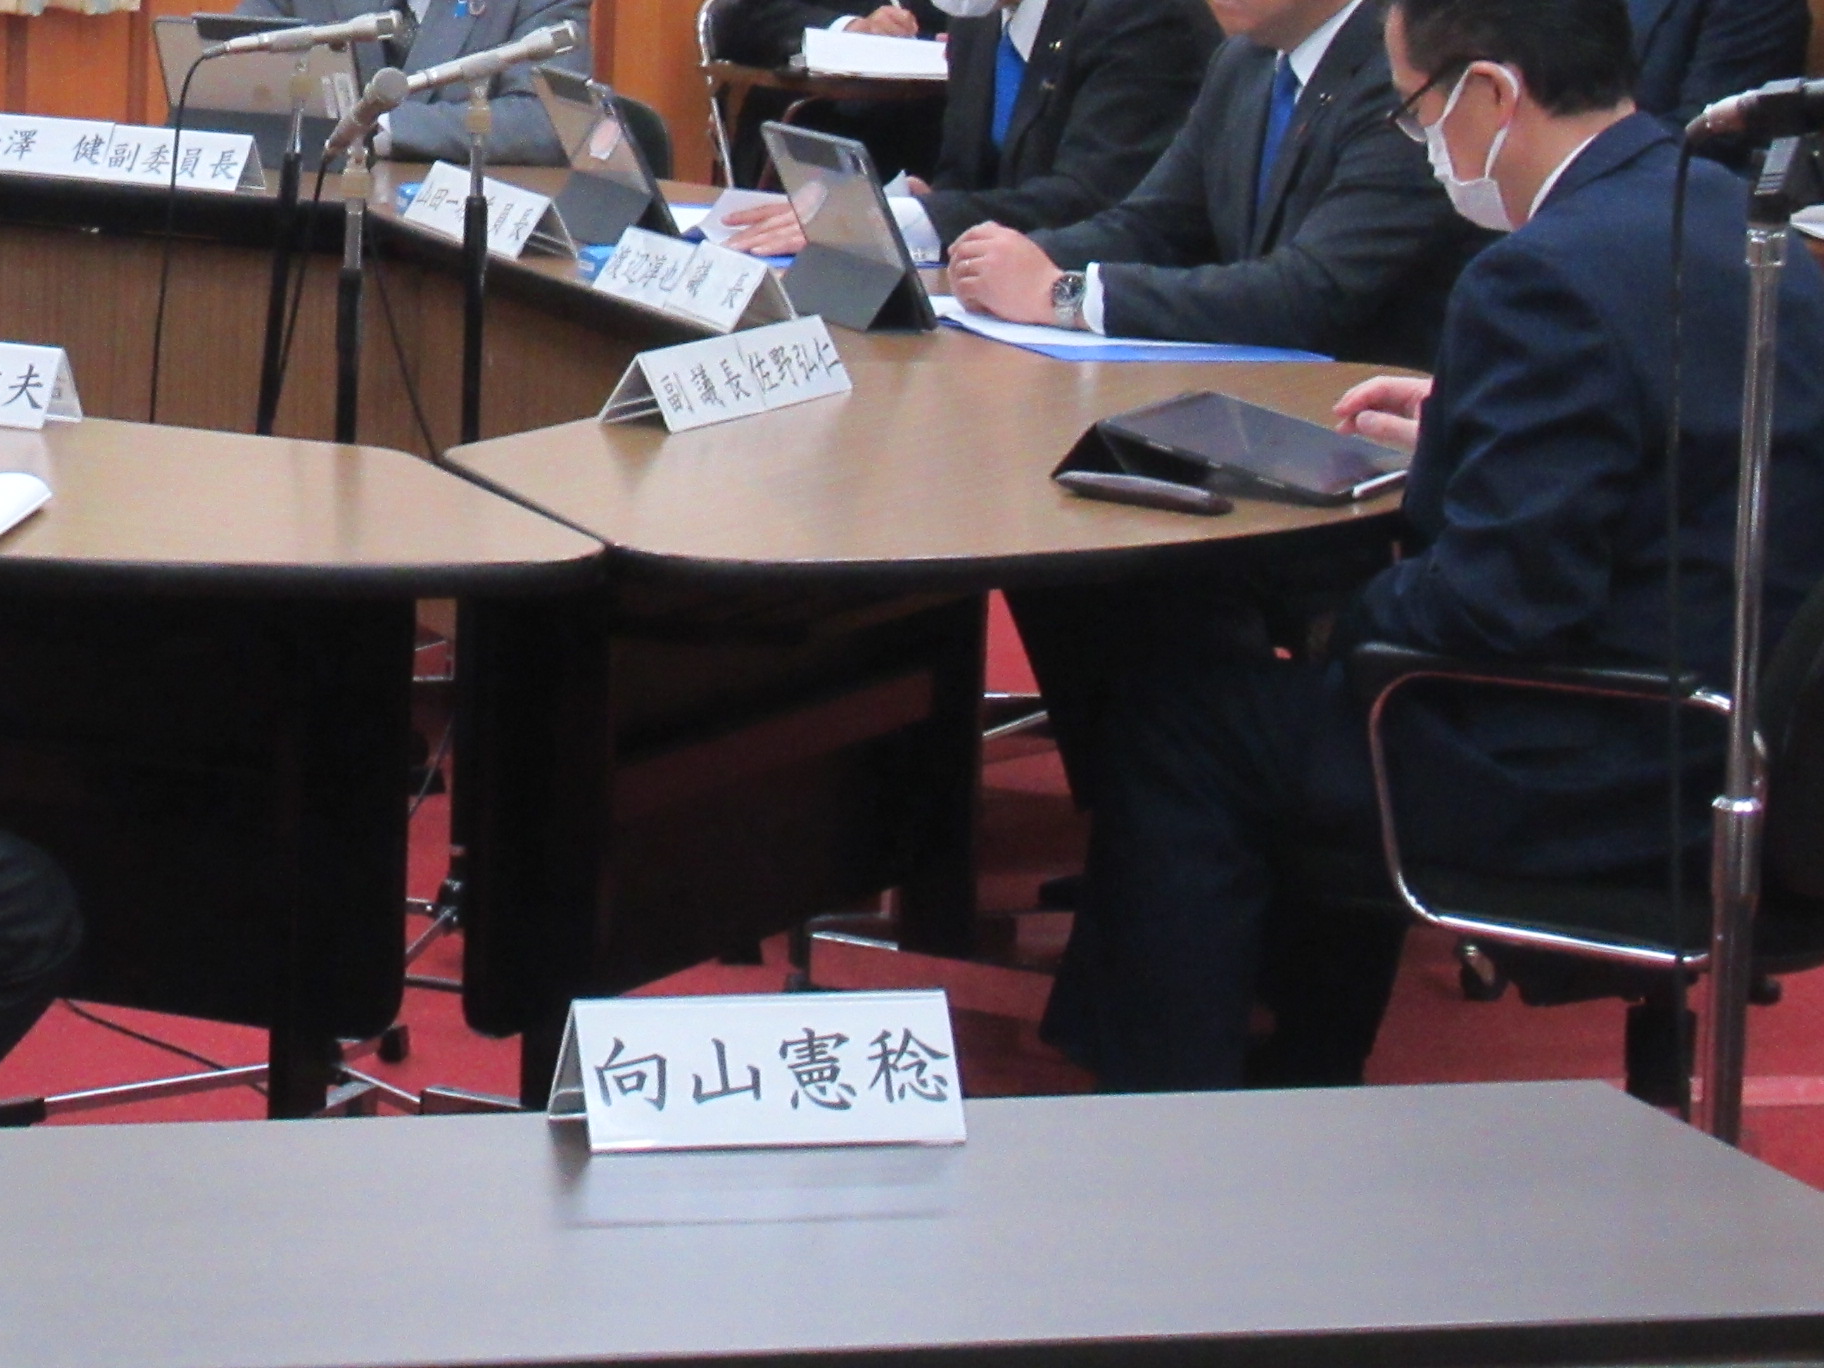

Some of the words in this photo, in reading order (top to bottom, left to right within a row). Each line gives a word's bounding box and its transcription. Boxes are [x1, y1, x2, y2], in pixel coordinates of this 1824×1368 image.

[108, 143, 240, 181] 副委員長
[659, 359, 751, 414] 副議長
[748, 336, 841, 394] 佐野弘仁
[593, 1027, 951, 1112] 向山憲稔
